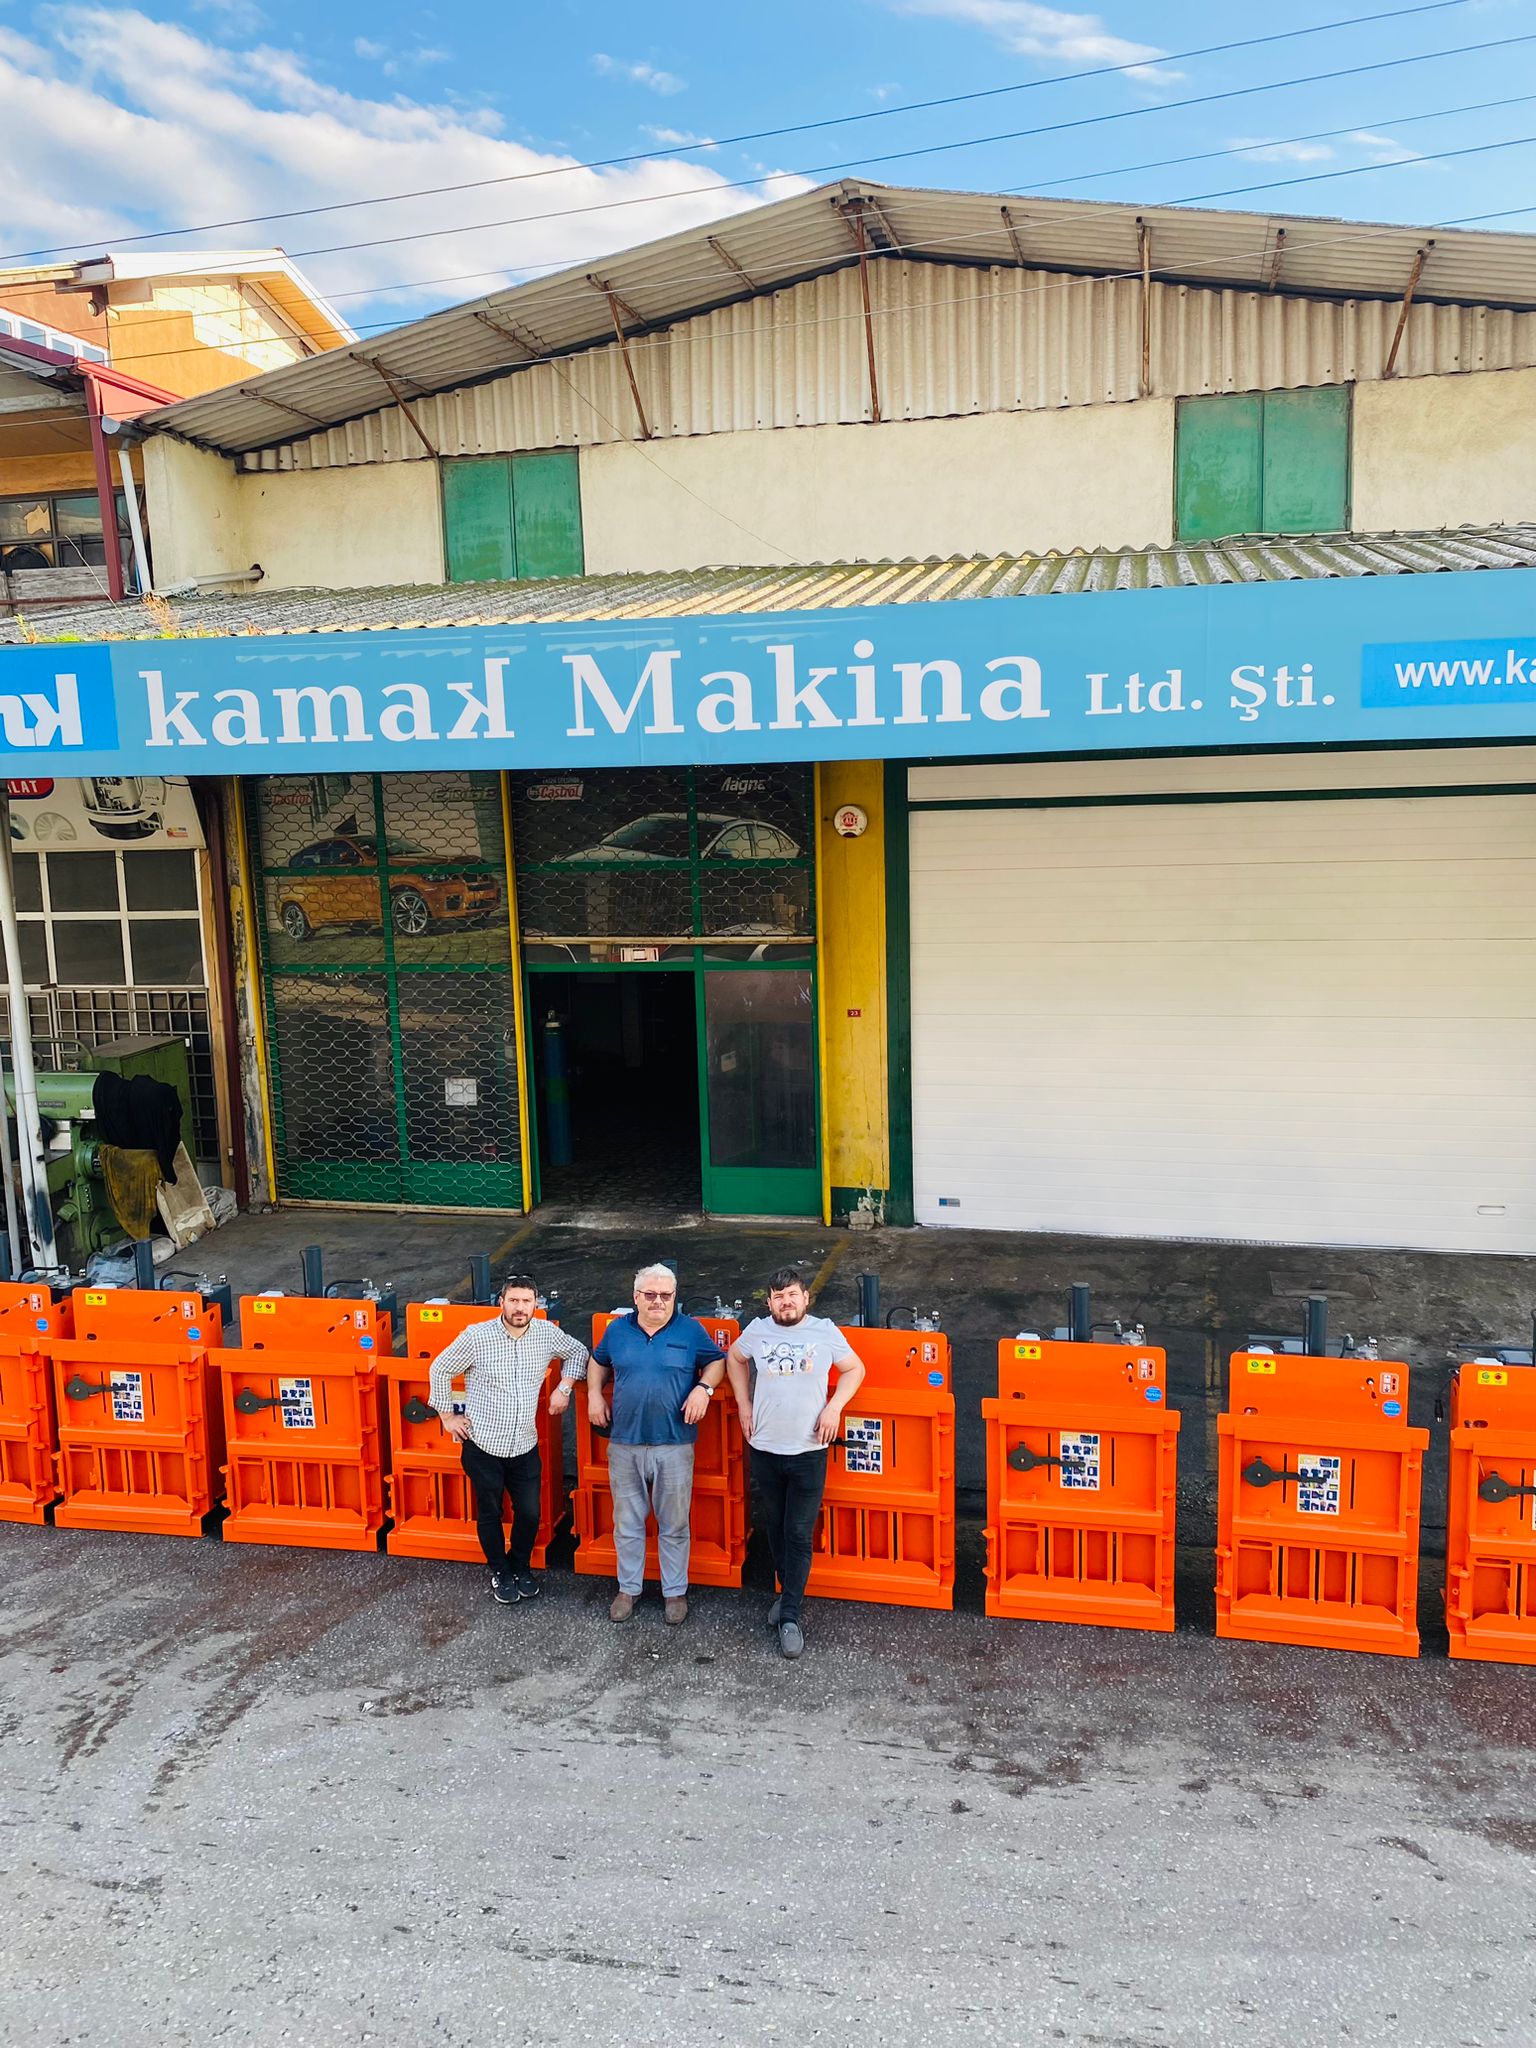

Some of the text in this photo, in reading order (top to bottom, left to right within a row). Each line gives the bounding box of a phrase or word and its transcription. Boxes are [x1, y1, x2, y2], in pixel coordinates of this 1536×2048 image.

[562, 640, 1051, 738] Makina
[1085, 669, 1205, 720] Ltd.
[1230, 664, 1336, 723] Şti.
[540, 785, 580, 800] Castrol
